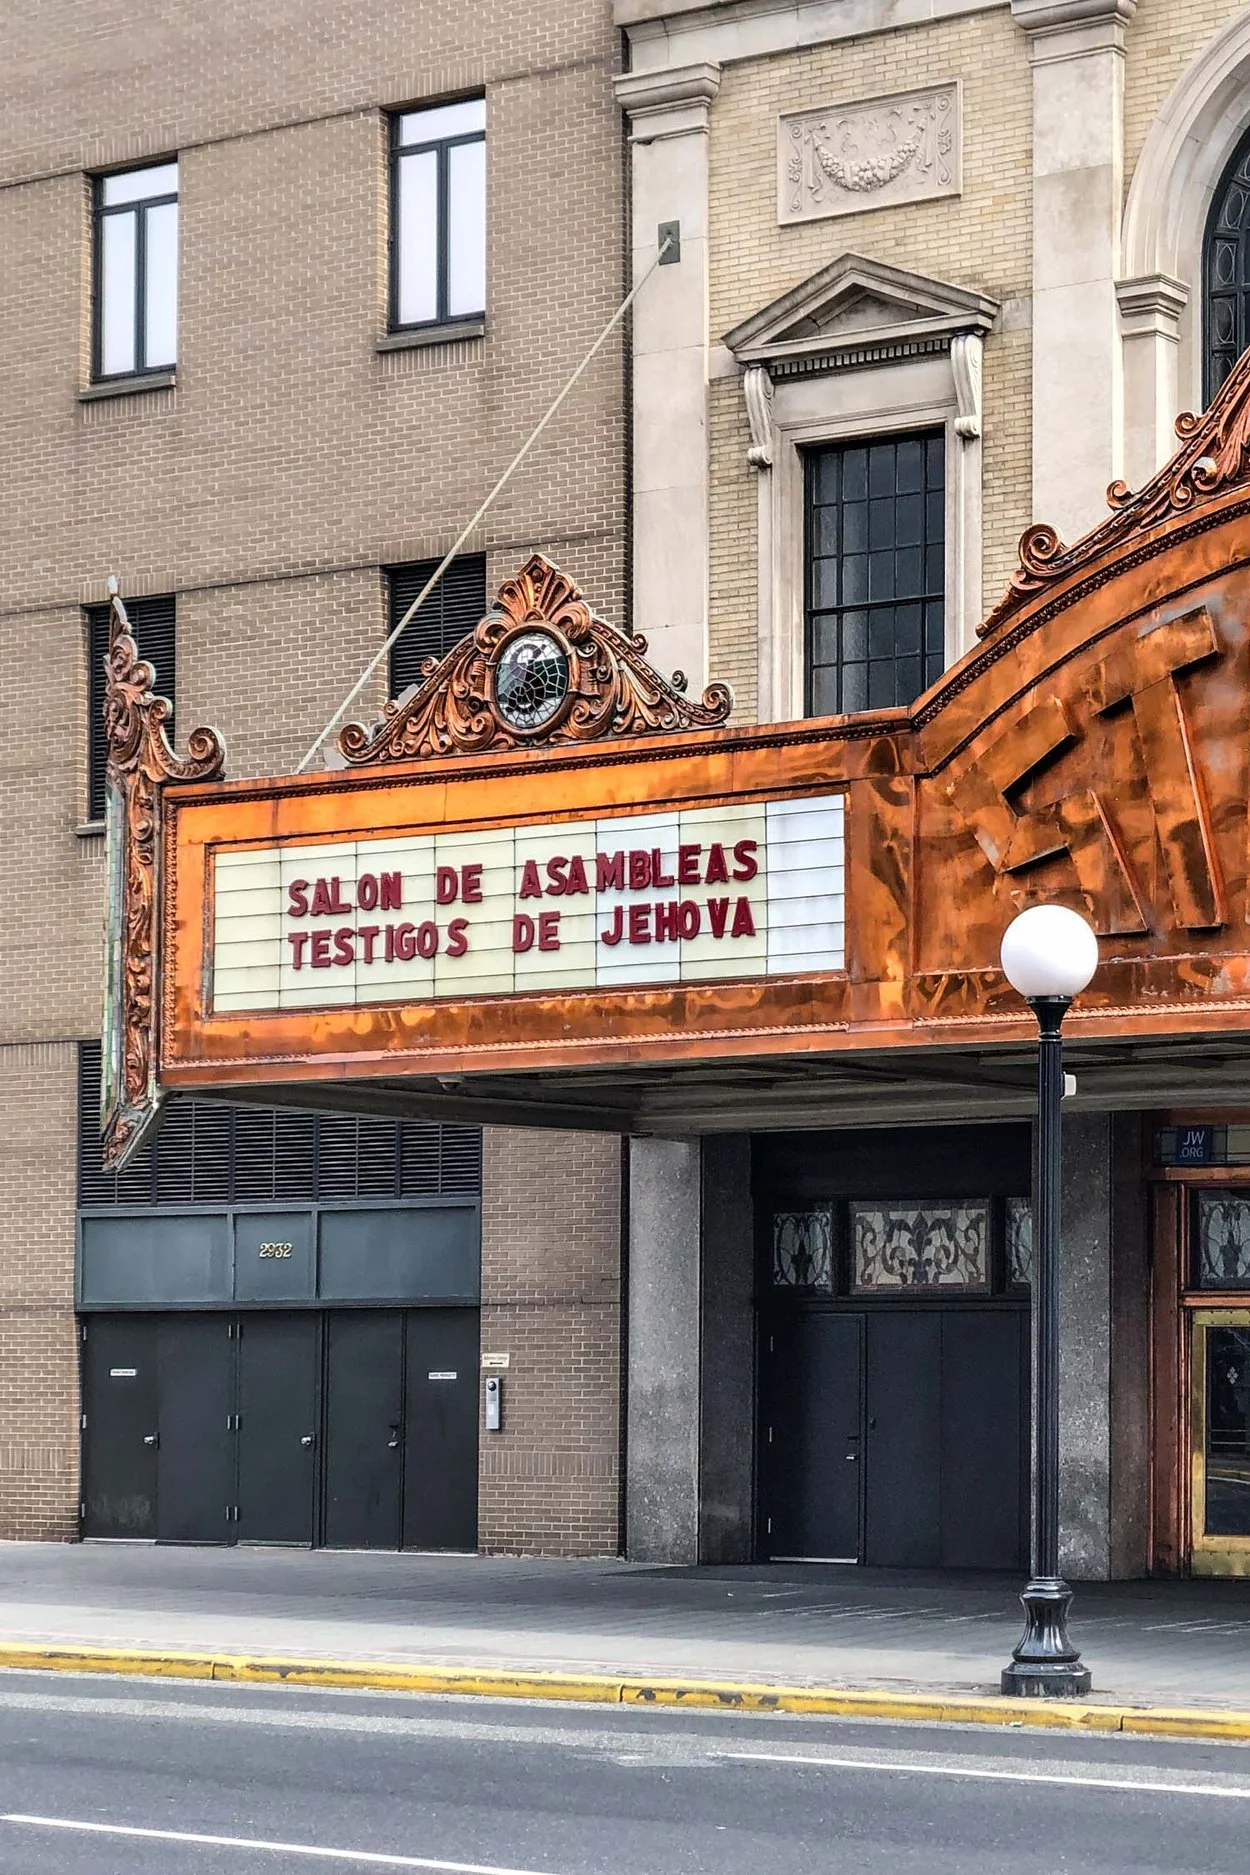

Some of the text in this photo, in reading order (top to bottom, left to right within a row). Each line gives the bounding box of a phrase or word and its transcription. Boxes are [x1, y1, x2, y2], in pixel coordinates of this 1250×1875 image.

[287, 840, 758, 918] SALON DE ASAMBLEAS
[288, 896, 757, 970] TESTIGOS DE JEHOVA
[1182, 1130, 1205, 1146] JW
[1180, 1146, 1204, 1158] .ORG
[259, 1242, 293, 1258] 2932
